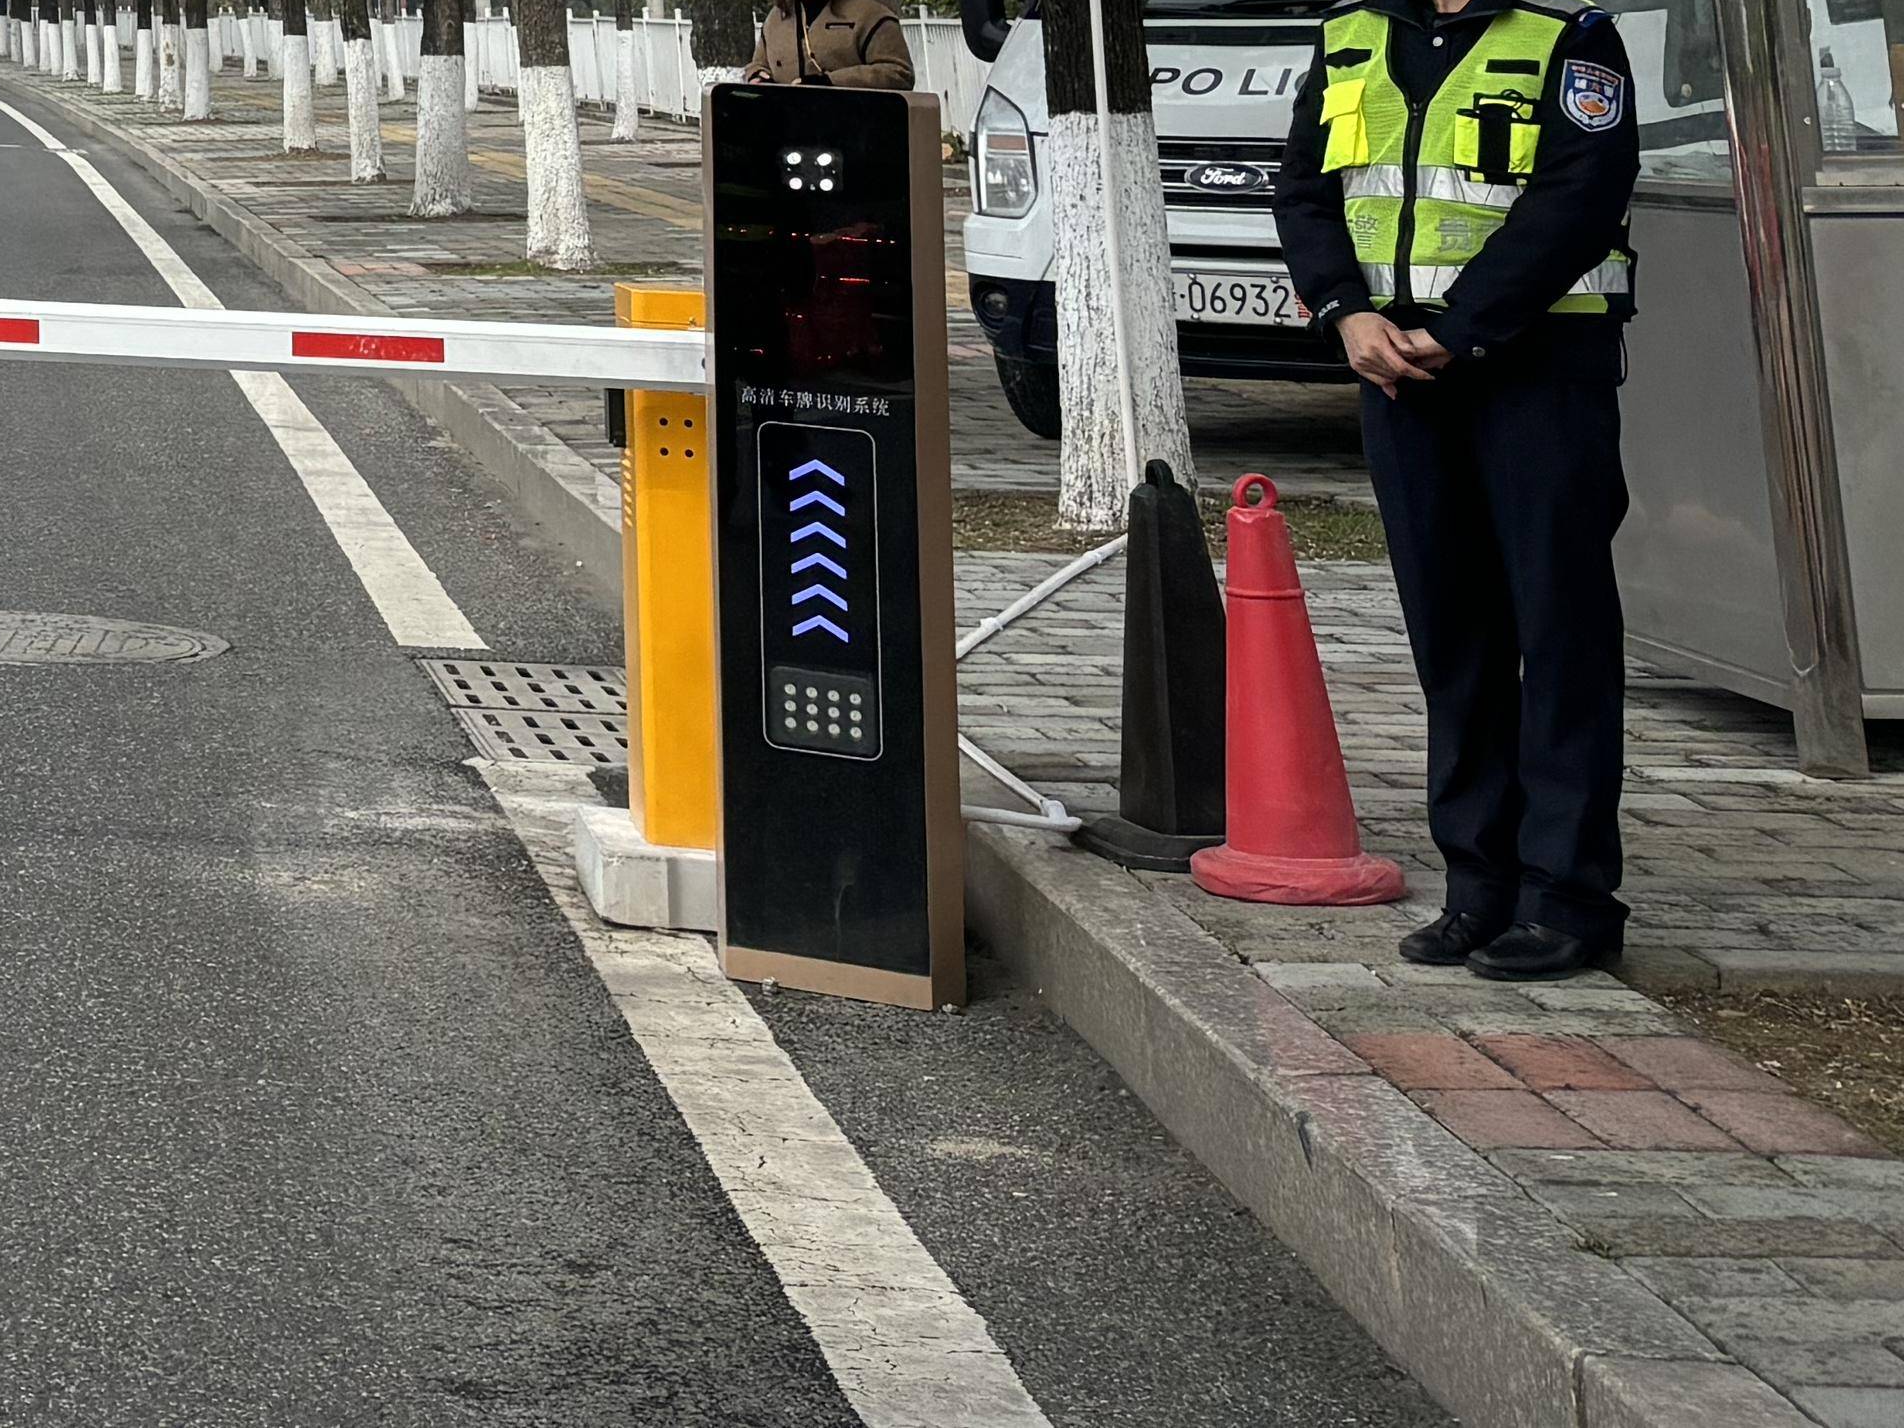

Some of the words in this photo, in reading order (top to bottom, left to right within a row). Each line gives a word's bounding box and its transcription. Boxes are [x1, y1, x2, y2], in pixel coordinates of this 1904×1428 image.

[1200, 167, 1247, 185] Ford
[741, 385, 891, 417] 高清车牌识别系统
